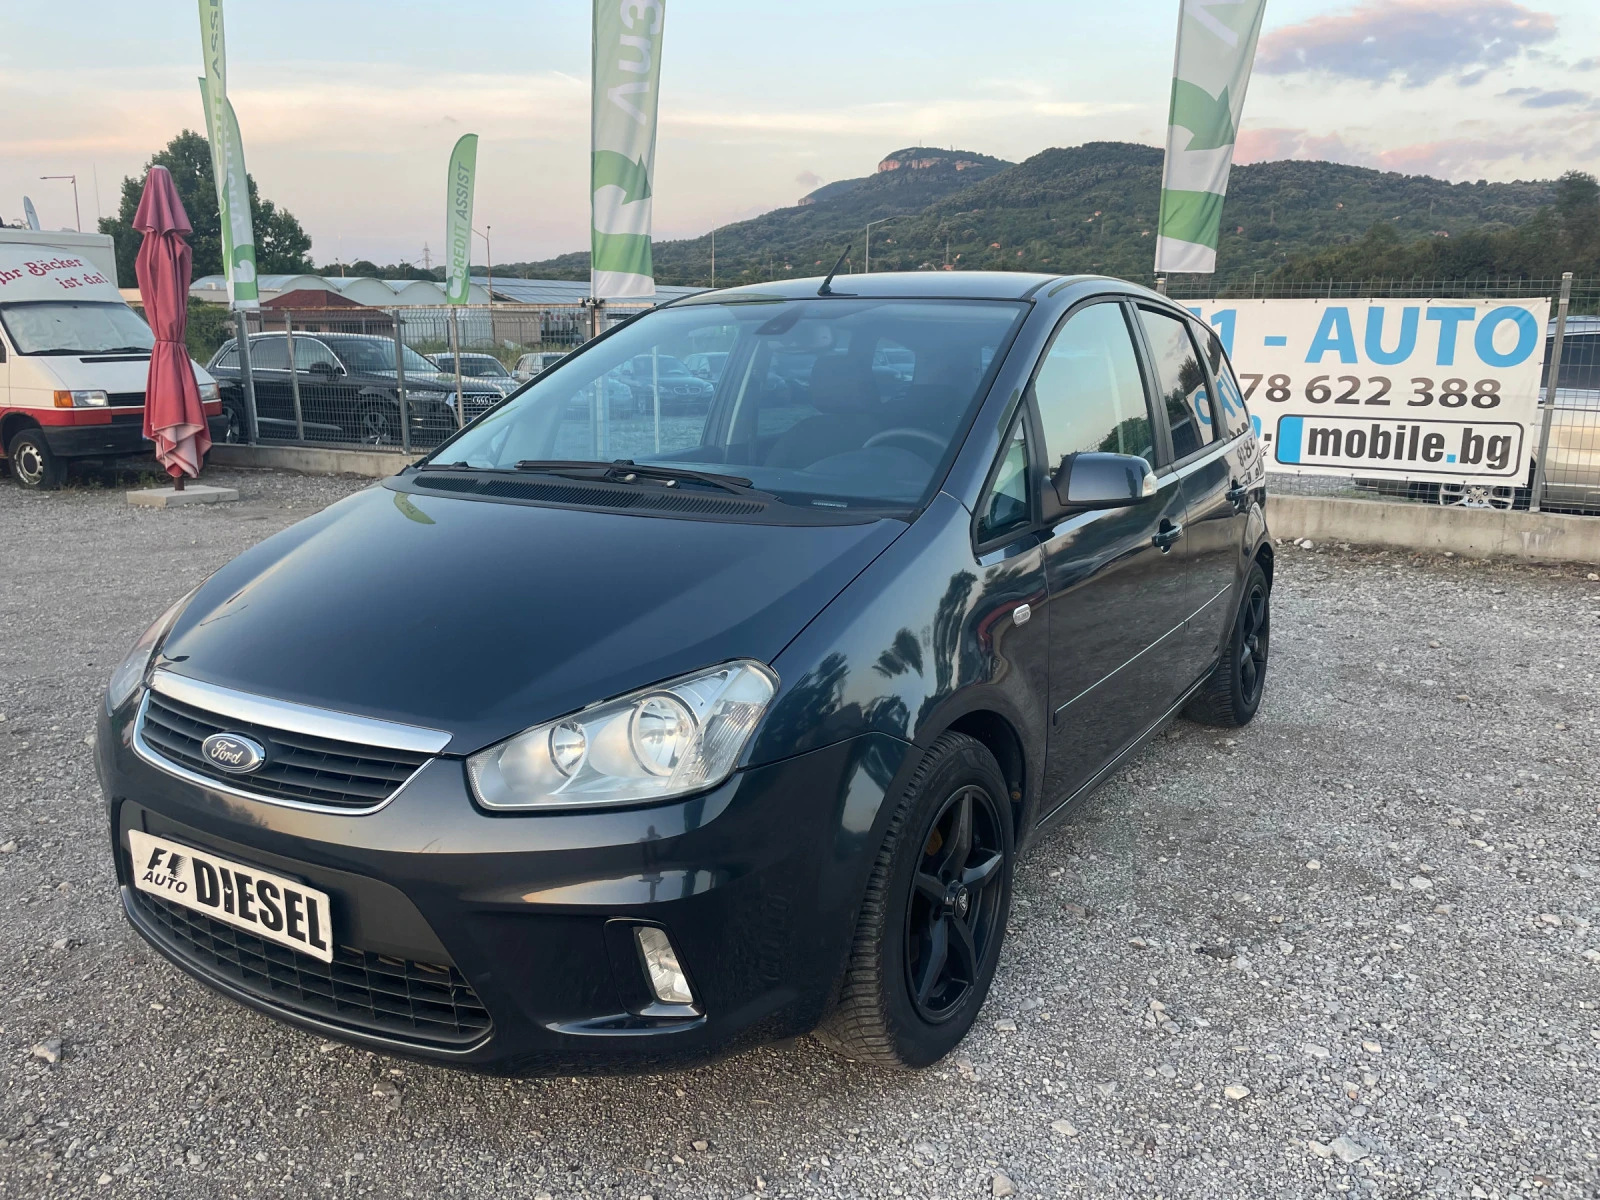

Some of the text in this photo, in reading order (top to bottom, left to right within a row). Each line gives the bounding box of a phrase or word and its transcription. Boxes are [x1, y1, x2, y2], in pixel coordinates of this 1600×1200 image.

[452, 161, 471, 281] CREDIT ASSIST
[23, 258, 84, 277] Bäcker
[55, 276, 84, 289] ist
[1304, 305, 1539, 368] AUTO
[1304, 375, 1392, 405] 622
[1406, 377, 1502, 409] 388
[1306, 422, 1513, 471] mobile.bg
[211, 739, 244, 765] Ford
[142, 870, 188, 894] AUTO
[191, 856, 327, 952] DIESEL
